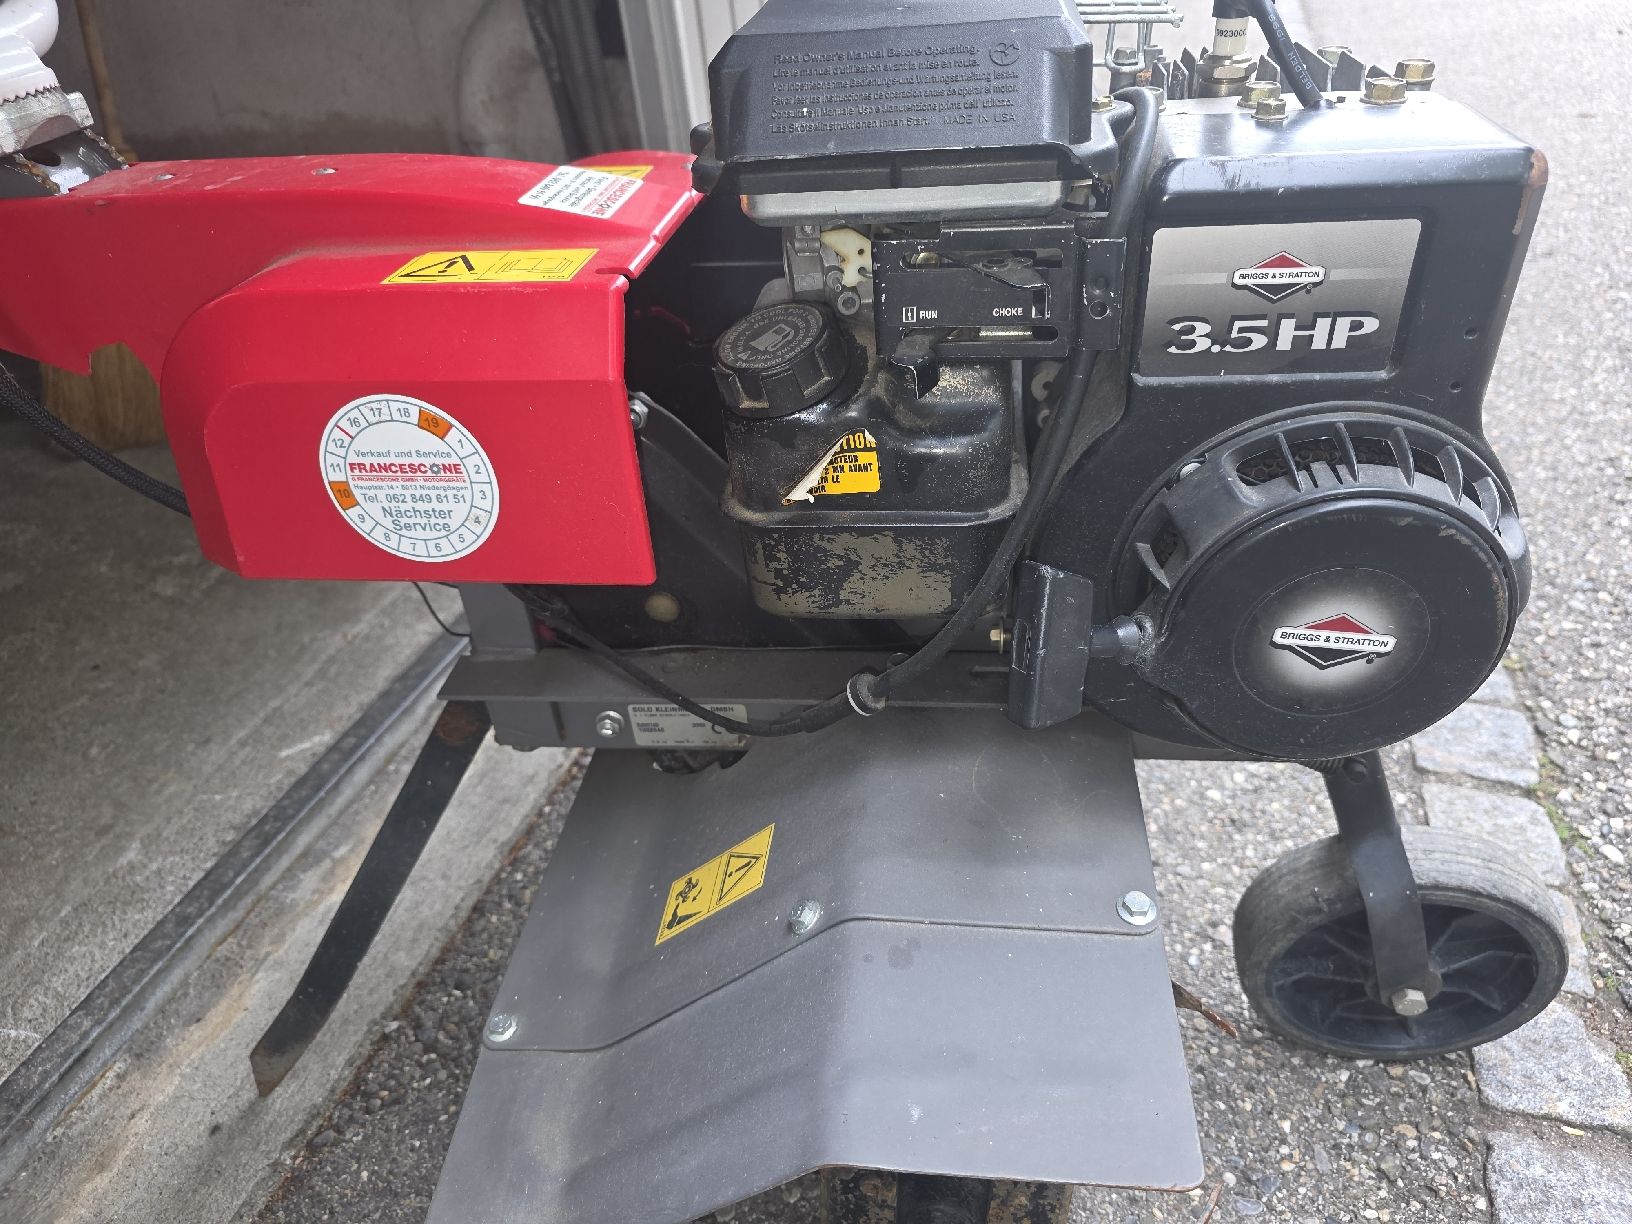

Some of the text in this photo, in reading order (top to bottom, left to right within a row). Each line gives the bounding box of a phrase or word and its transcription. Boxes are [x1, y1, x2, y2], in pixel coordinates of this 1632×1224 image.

[774, 44, 980, 65] Read Owner's Manual Before Operating.
[943, 112, 1017, 125] MADE IN USA
[1238, 271, 1320, 281] BRIGGS & STRATTON
[919, 307, 1024, 320] RUN CHOKE
[369, 407, 383, 419] 17
[396, 407, 411, 419] 18
[346, 417, 361, 429] 16
[424, 417, 440, 429] 19
[331, 437, 347, 450] 12
[457, 438, 465, 450] 1
[353, 449, 452, 459] Verkauf und Service
[329, 462, 342, 473] 11
[348, 462, 464, 475] FRANCESCONE
[473, 464, 482, 475] 2
[848, 463, 873, 473] AVANT
[831, 474, 841, 484] LE
[336, 488, 350, 499] 10
[361, 493, 467, 504] Tel. 062 849 61 51
[479, 489, 488, 501] 3
[381, 505, 454, 520] Nächster
[357, 513, 366, 524] 9
[473, 515, 482, 526] 4
[391, 519, 452, 533] Service
[383, 532, 392, 543] 8
[457, 533, 466, 543] 5
[409, 542, 417, 552] 7
[434, 542, 443, 552] 6
[1279, 631, 1389, 648] BRIGGS & STRATTON
